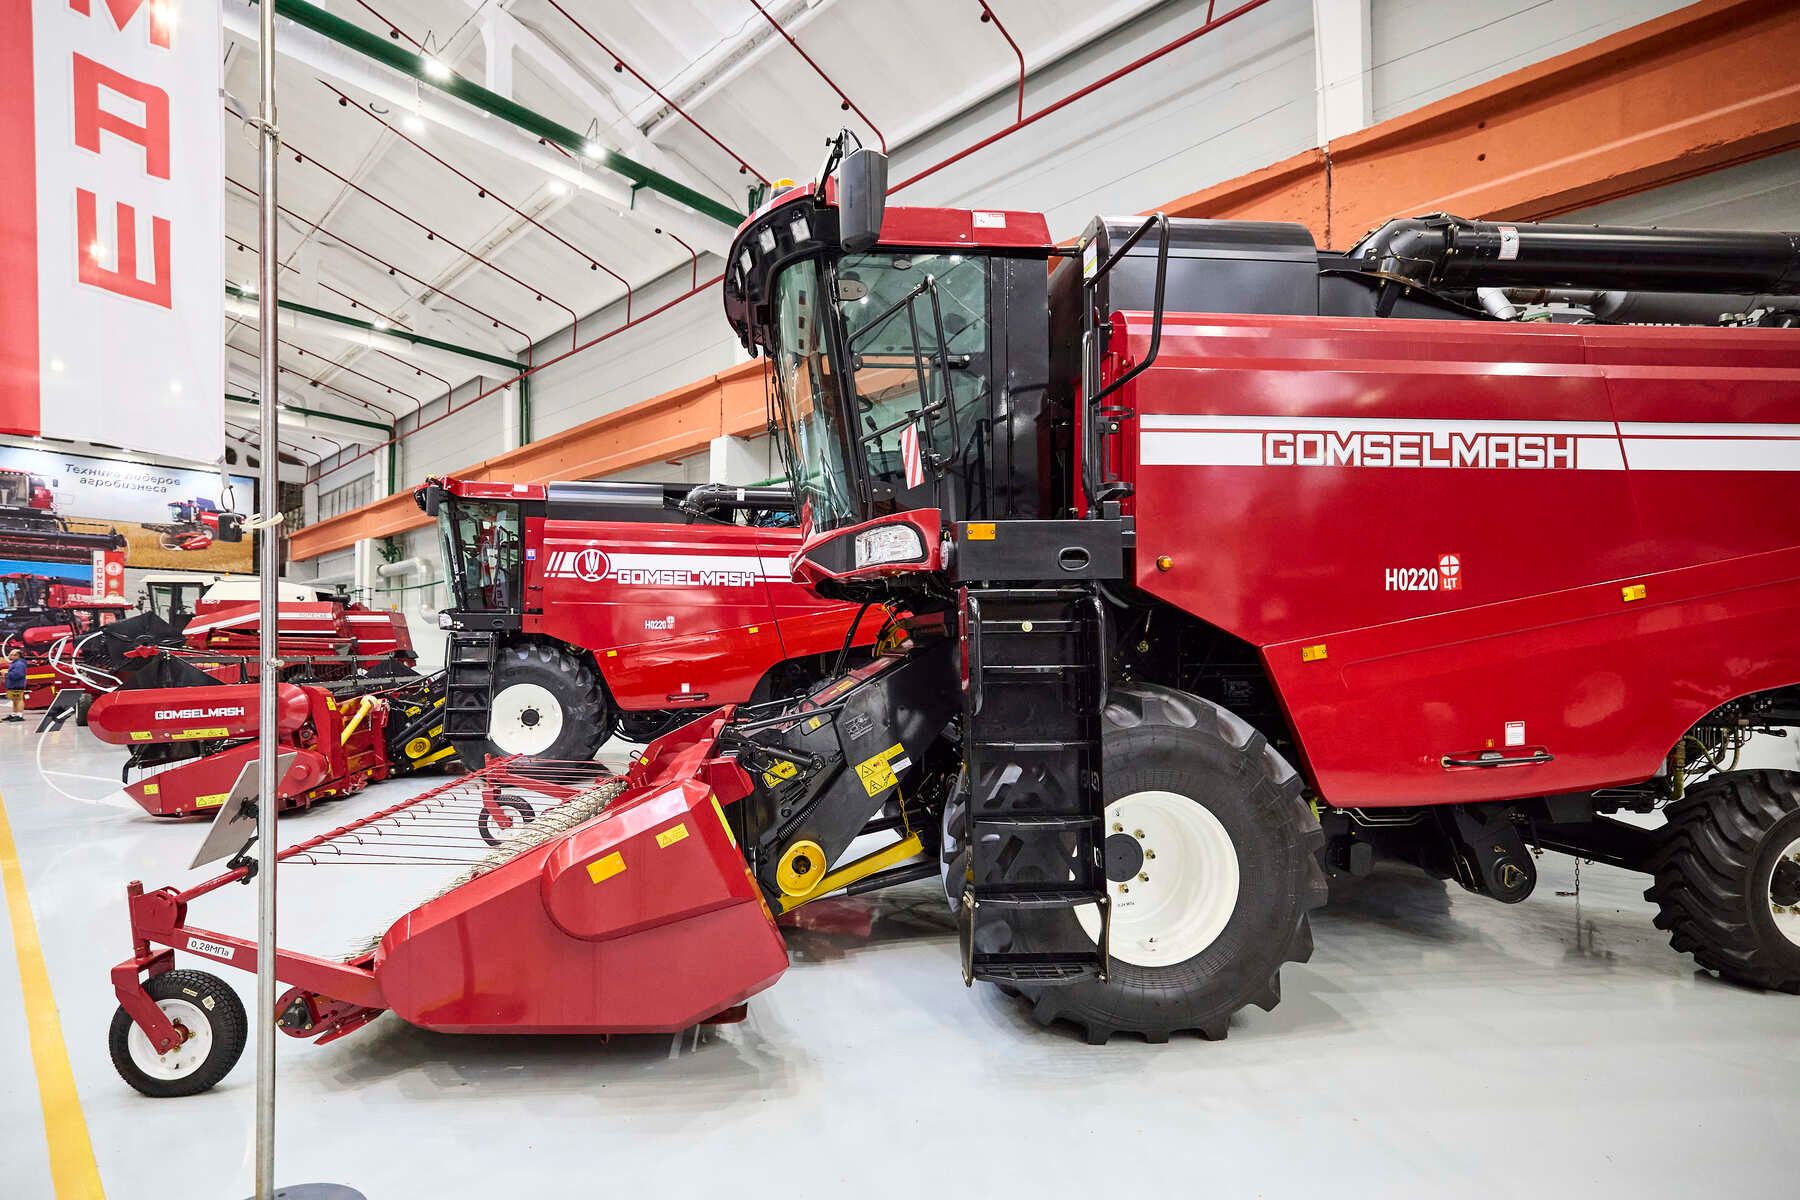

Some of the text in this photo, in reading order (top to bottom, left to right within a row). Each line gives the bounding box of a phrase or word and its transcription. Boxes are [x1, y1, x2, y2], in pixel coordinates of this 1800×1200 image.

[1265, 432, 1575, 469] GOMSELMASH
[79, 476, 167, 494] агробизнеса
[617, 569, 755, 587] GOMSELMASH
[154, 706, 245, 720] GOMSELMASH
